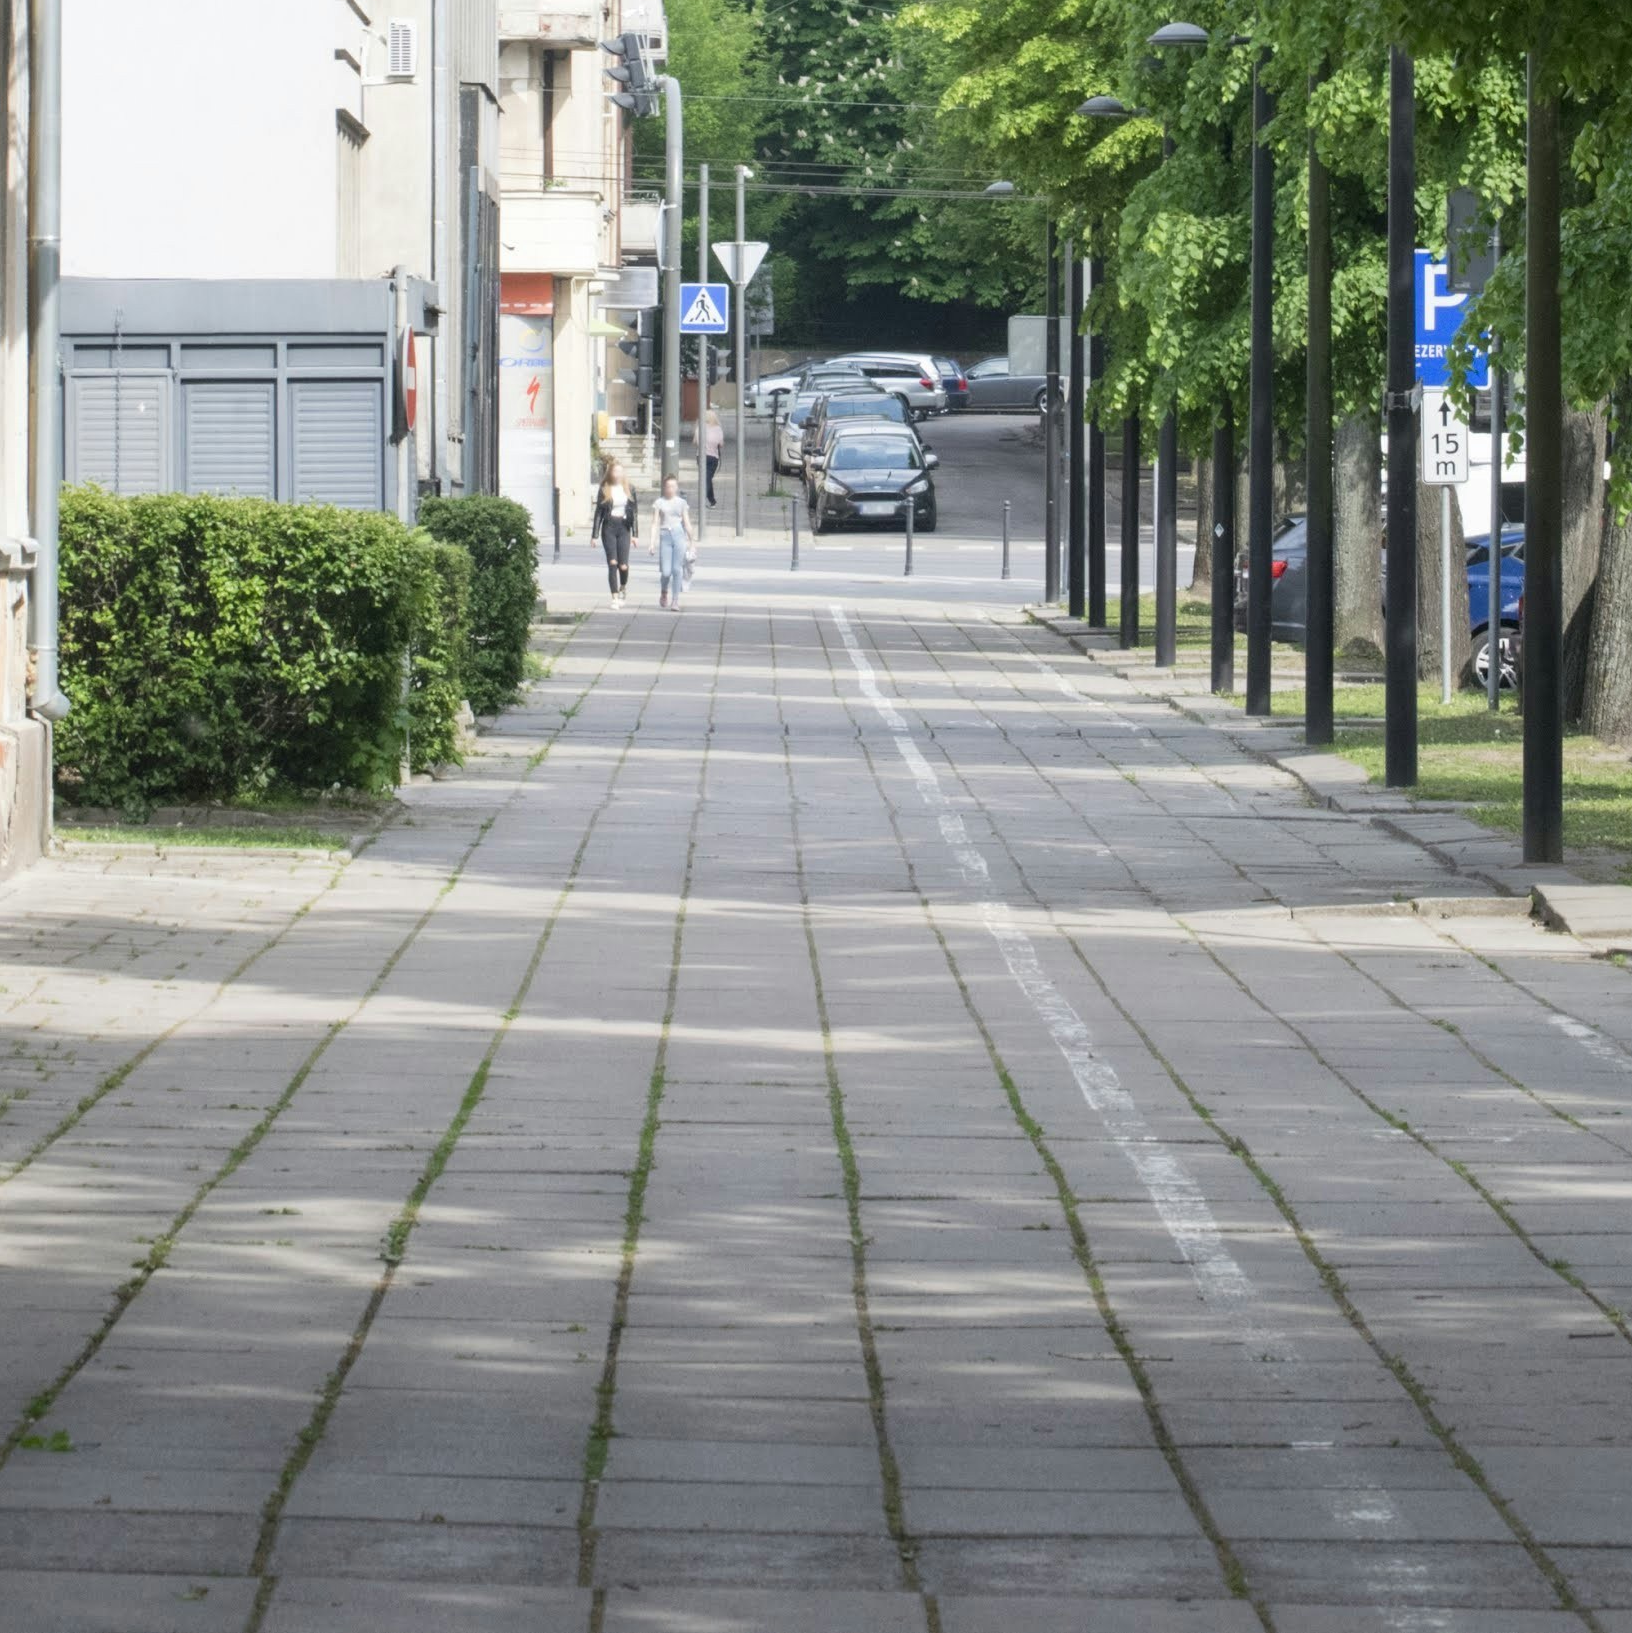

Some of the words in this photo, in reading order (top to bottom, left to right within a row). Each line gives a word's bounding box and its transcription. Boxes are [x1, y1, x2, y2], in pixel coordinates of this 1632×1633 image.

[1424, 263, 1468, 331] P
[1431, 433, 1460, 455] 15
[1436, 460, 1456, 475] m
